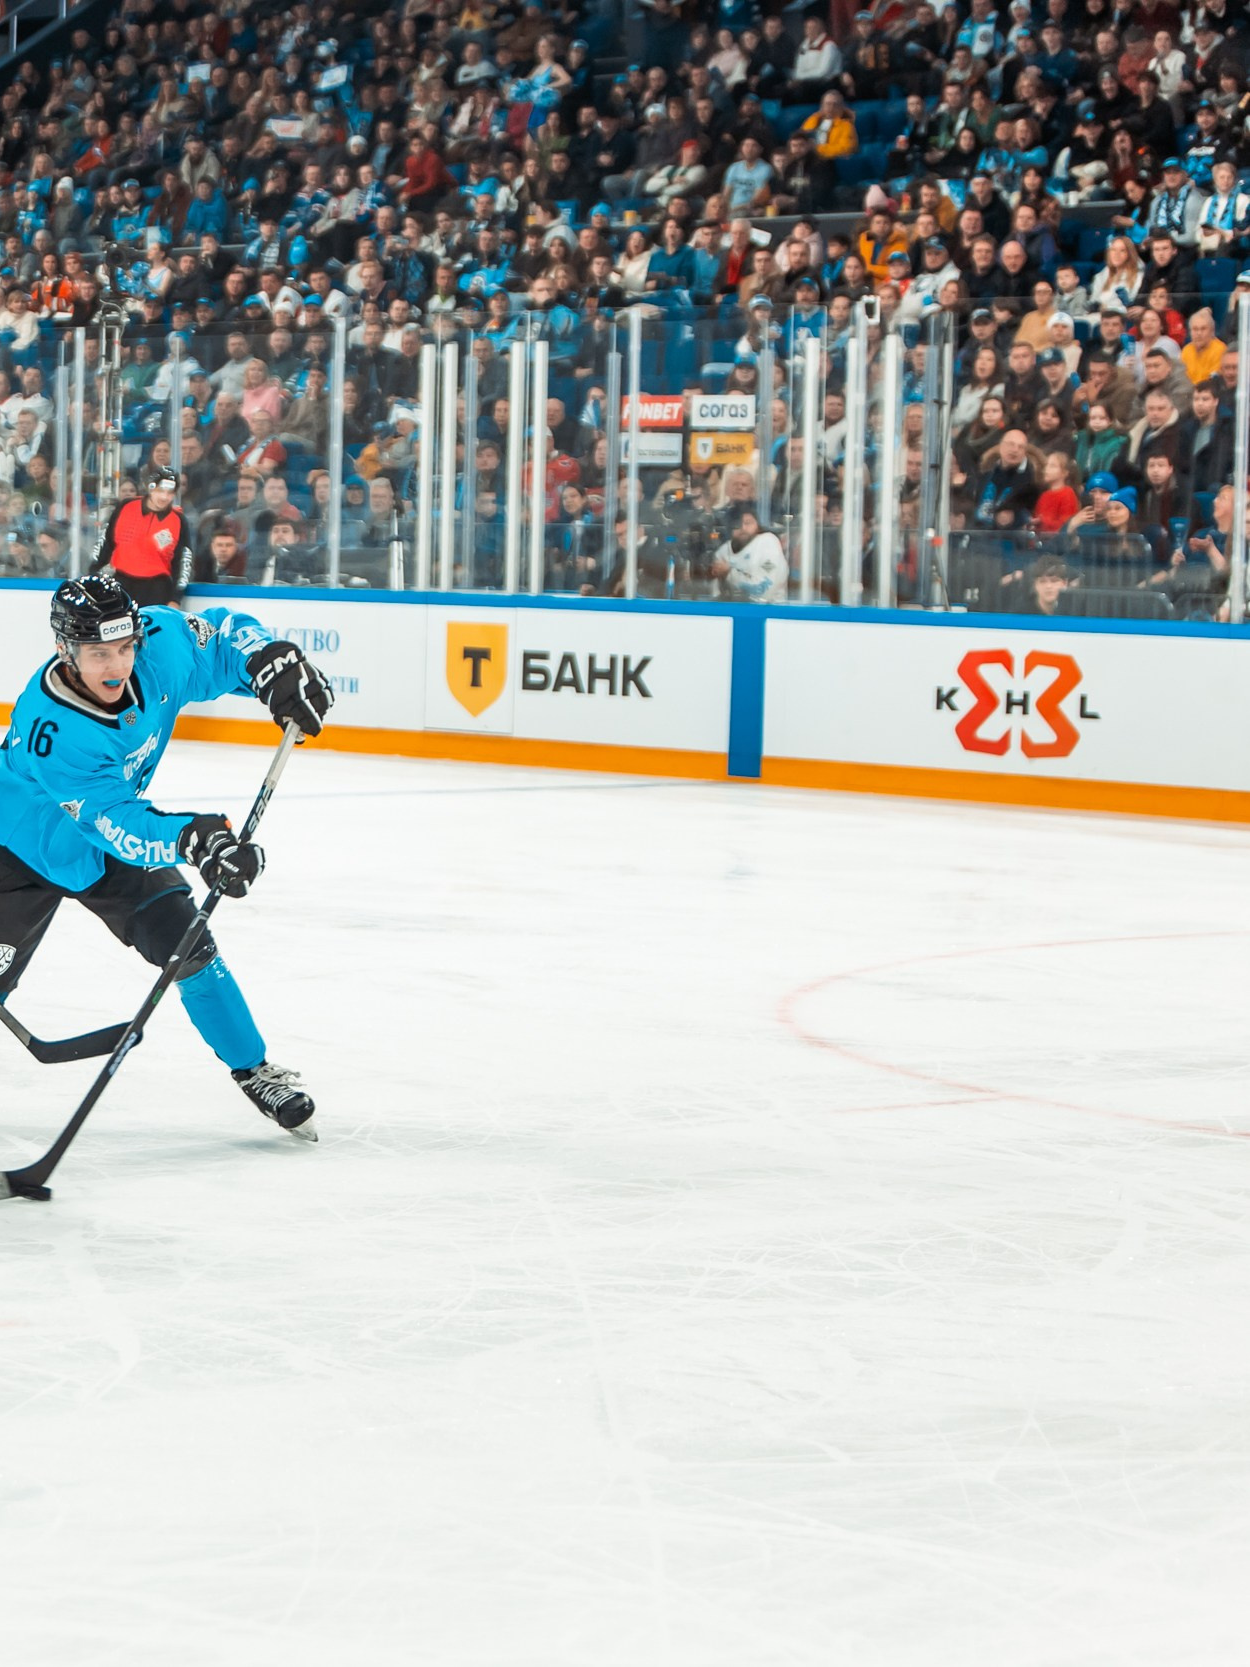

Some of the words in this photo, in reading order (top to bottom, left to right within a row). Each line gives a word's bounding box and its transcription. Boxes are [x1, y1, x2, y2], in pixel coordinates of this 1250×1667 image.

[256, 650, 299, 688] CM
[521, 649, 653, 698] БАНК
[27, 716, 59, 758] 16
